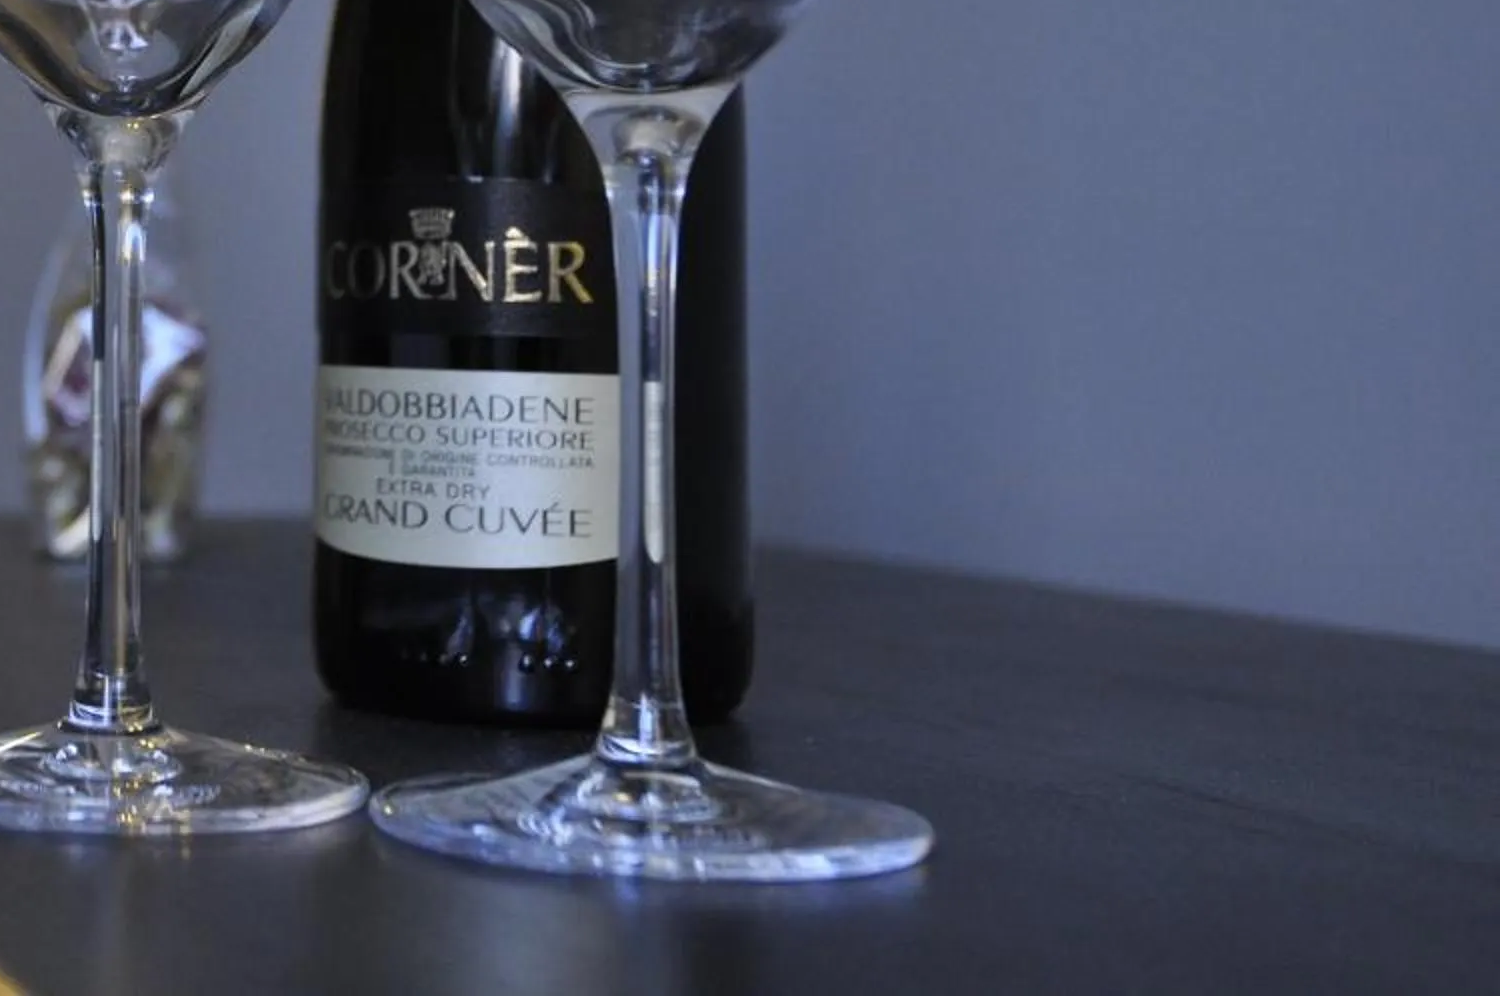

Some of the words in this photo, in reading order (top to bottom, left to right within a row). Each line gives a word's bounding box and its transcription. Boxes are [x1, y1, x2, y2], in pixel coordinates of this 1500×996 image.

[436, 425, 594, 452] SUPERIORE
[487, 453, 595, 469] CONTROLLATA
[376, 477, 437, 498] EXTRA
[446, 482, 491, 501] DRY
[325, 493, 429, 529] GRAND
[444, 502, 593, 538] CUVÉE
